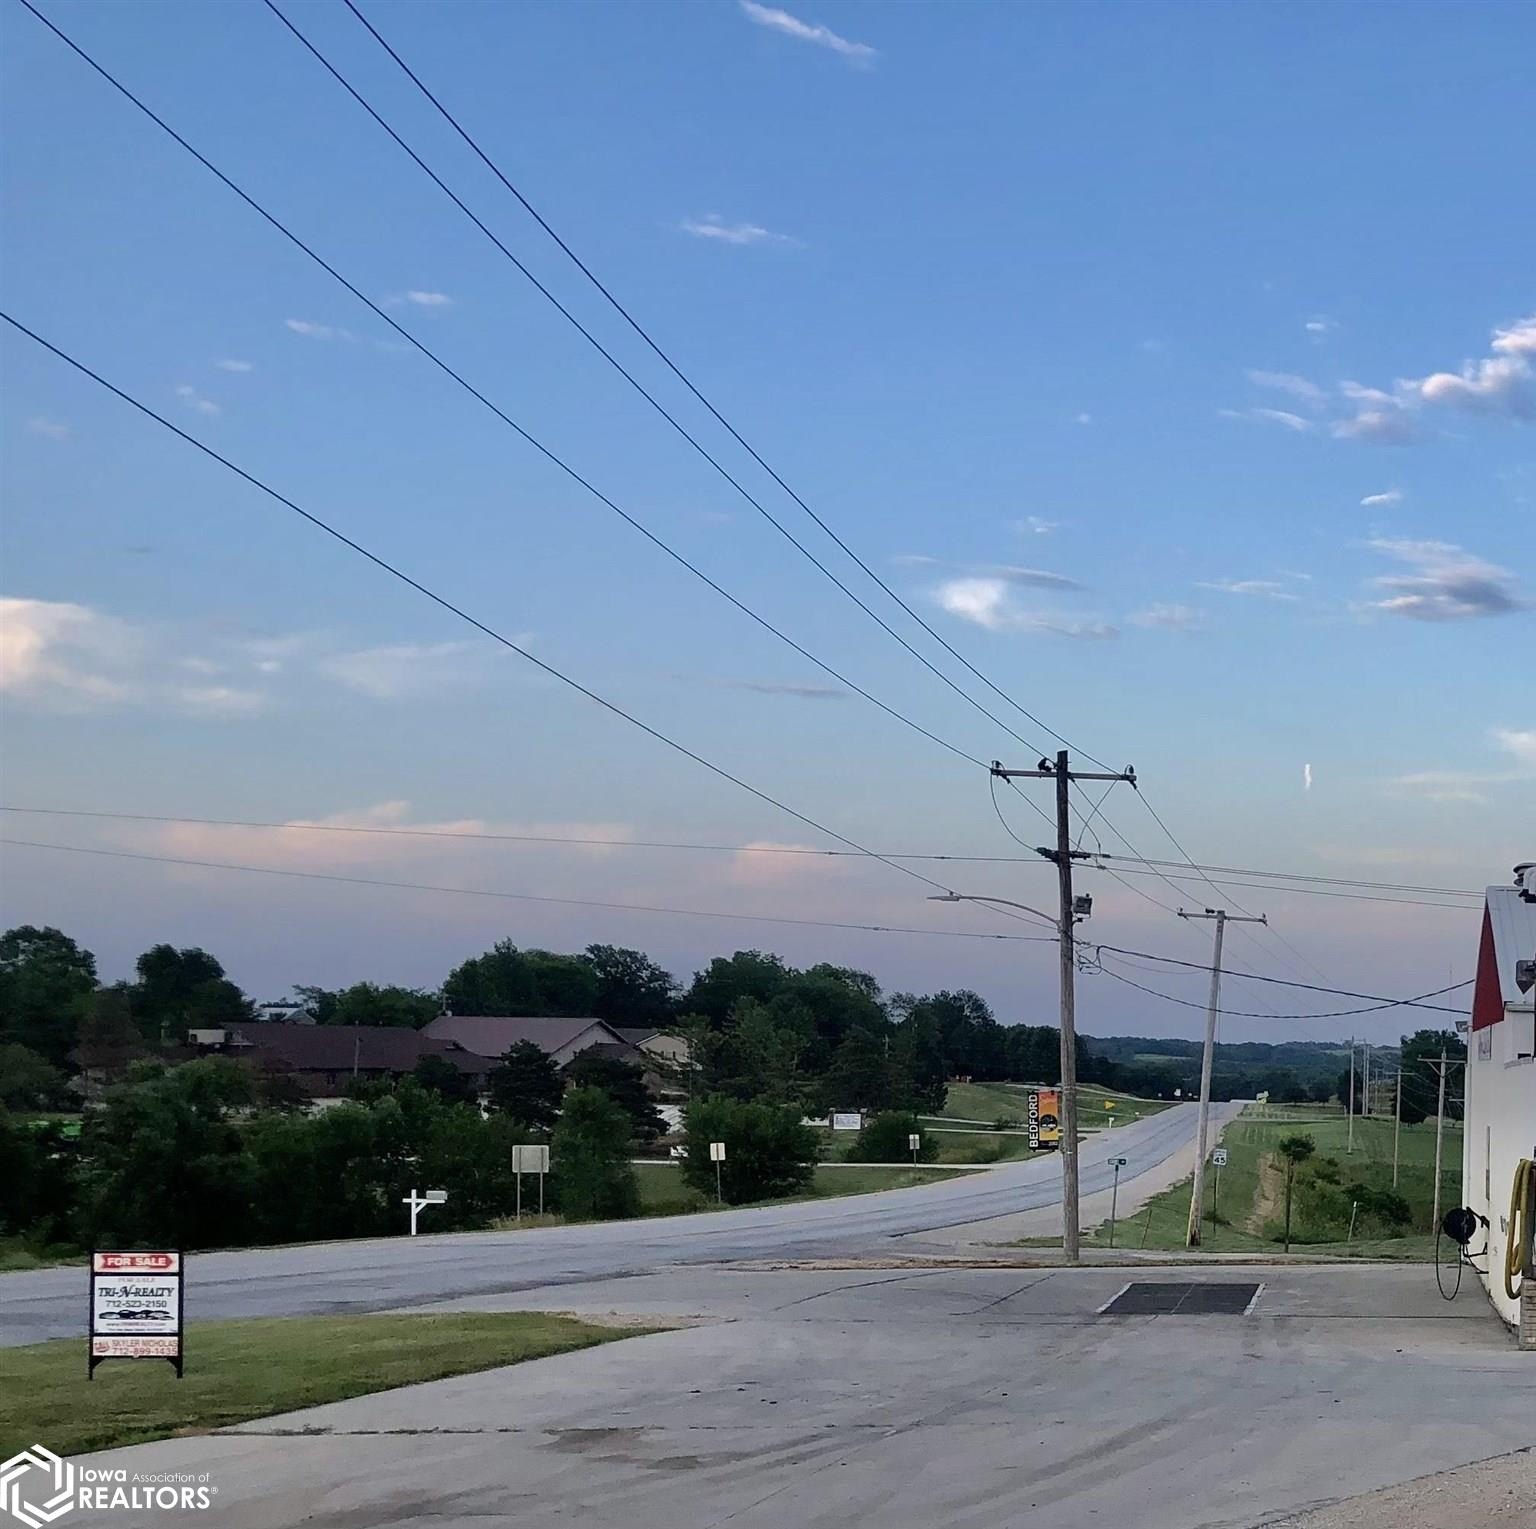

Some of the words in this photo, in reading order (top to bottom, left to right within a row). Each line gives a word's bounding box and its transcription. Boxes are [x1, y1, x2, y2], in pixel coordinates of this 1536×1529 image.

[1028, 1094, 1039, 1148] BEDFORD
[107, 1257, 131, 1267] FOR
[136, 1257, 167, 1267] SALE
